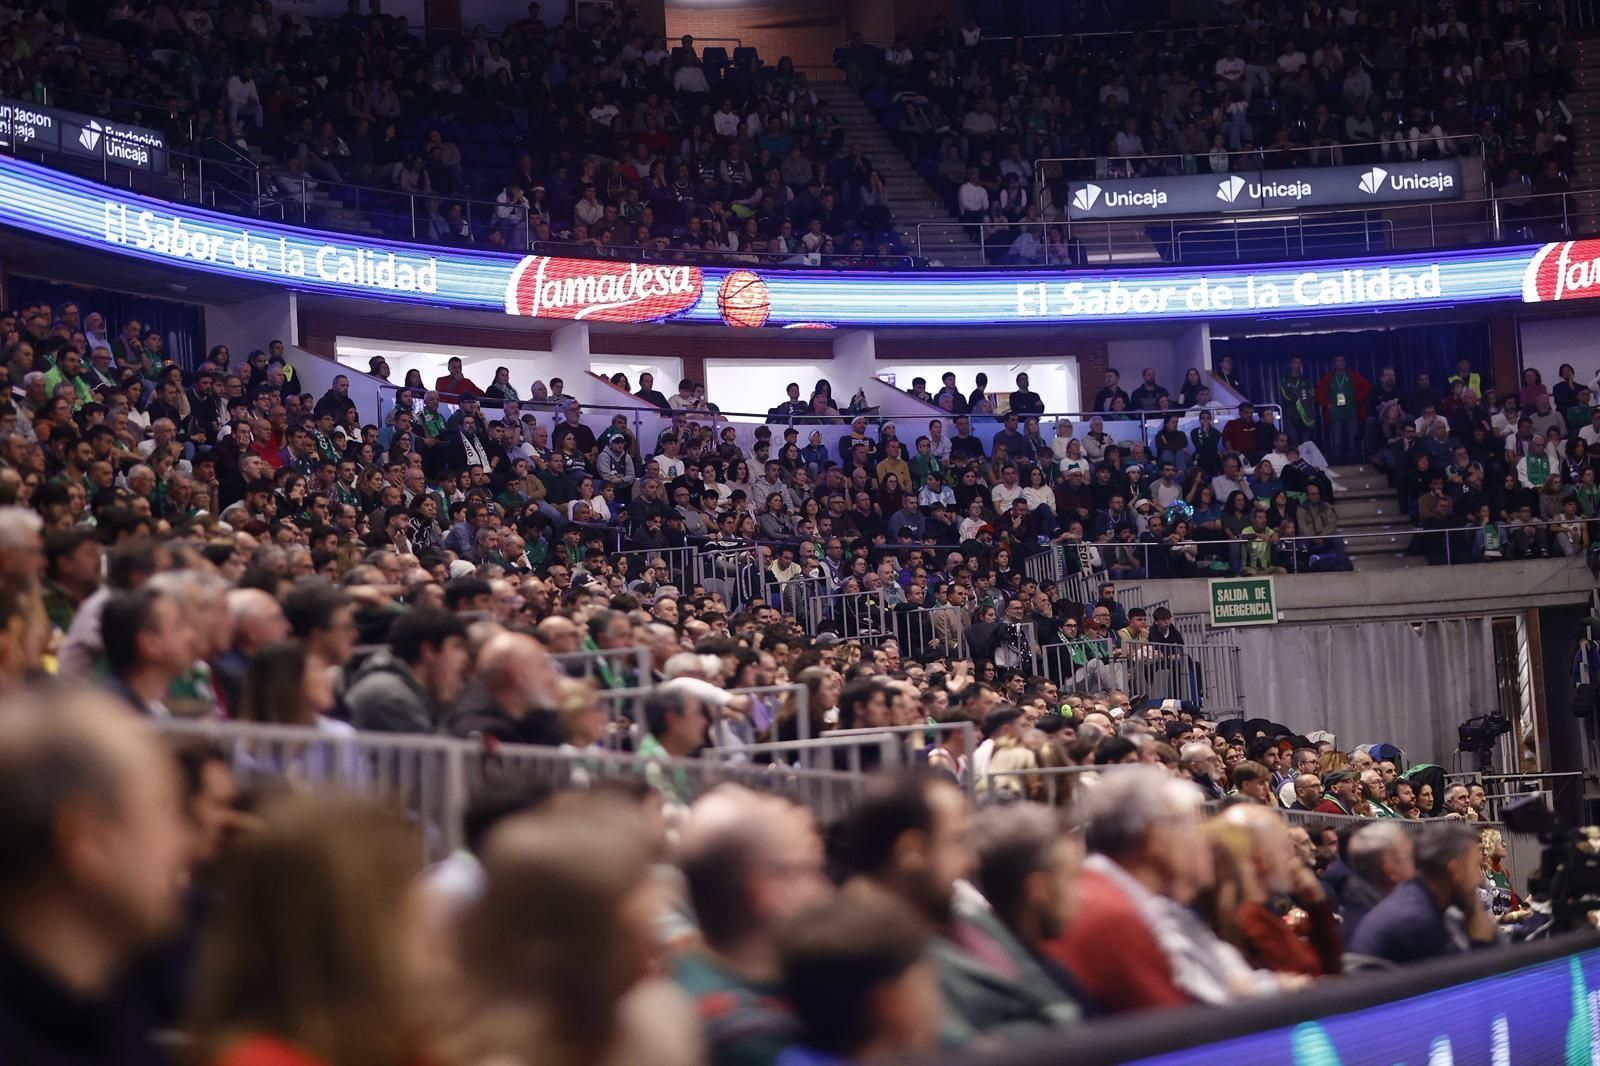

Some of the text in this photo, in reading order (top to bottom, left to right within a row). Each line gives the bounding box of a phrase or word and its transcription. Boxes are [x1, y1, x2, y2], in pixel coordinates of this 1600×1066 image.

[105, 140, 148, 165] Unicaja
[1248, 180, 1312, 200] Unicaja
[1390, 172, 1453, 192] Unicaja
[1104, 189, 1168, 209] Unicaja
[104, 201, 437, 294] El Sabor de la Calidad
[1017, 264, 1441, 317] El Sabor de la Calidad
[1217, 587, 1267, 602] SALIDA DE
[1215, 603, 1271, 617] EMERGENCIA
